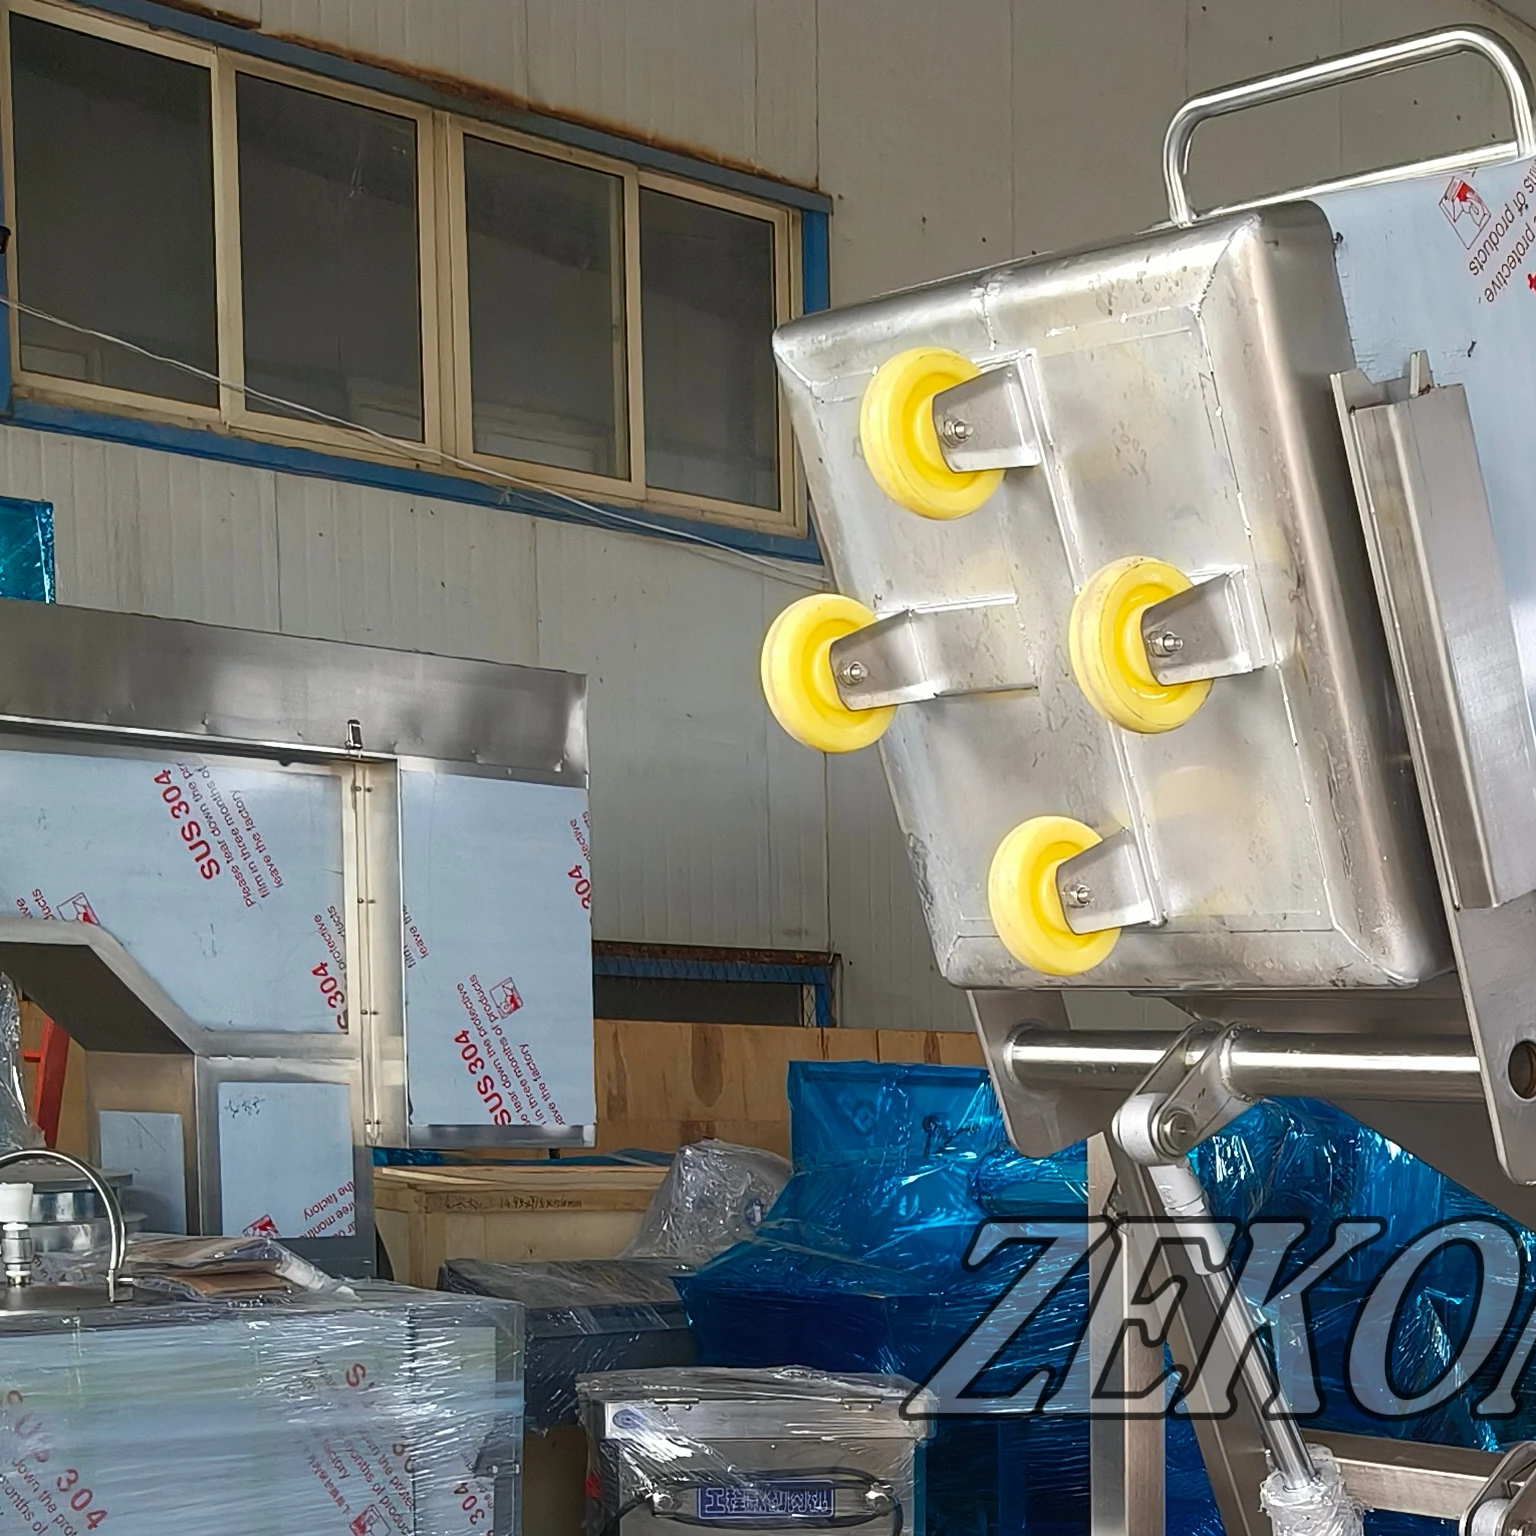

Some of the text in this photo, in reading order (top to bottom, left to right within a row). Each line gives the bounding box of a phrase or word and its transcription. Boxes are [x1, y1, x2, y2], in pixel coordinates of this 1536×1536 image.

[1470, 204, 1515, 276] products
[1485, 222, 1535, 302] protective
[154, 769, 189, 819] 304
[207, 781, 234, 826] months
[181, 820, 220, 879] SUS
[188, 781, 256, 907] Please tear down the
[231, 790, 283, 888] leave the factory
[232, 828, 250, 861] three
[249, 862, 258, 873] in
[255, 874, 270, 898] film
[410, 926, 429, 959] leave
[311, 962, 345, 1008] 304
[470, 974, 498, 1023] products
[457, 983, 522, 1113] tear down the protective
[492, 1025, 502, 1035] of
[454, 1030, 511, 1126] SUS 304
[500, 1037, 523, 1078] months
[519, 1043, 541, 1082] factory
[520, 1080, 538, 1109] three
[539, 1082, 551, 1101] the
[304, 1194, 338, 1219] factory
[39, 1487, 57, 1513] the
[57, 1468, 108, 1530] 304
[454, 1483, 485, 1525] 304
[32, 1522, 48, 1536] of
